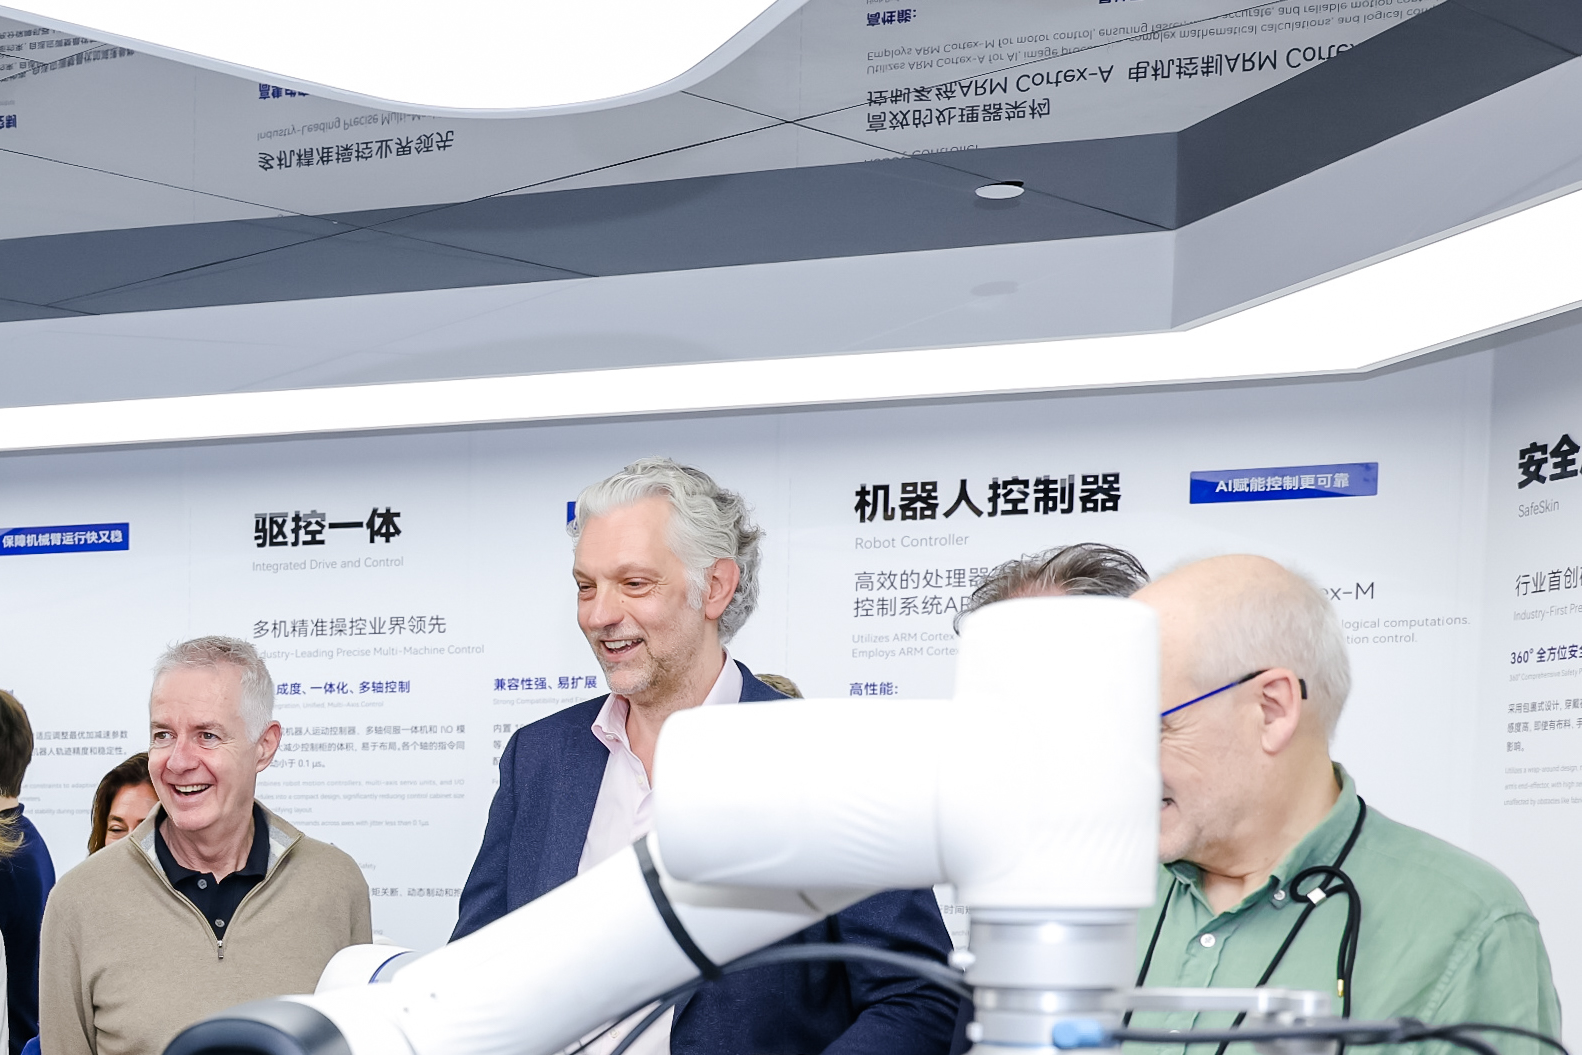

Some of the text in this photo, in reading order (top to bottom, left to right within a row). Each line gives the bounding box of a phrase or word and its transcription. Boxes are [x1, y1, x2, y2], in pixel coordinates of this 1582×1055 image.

[1517, 433, 1582, 490] 安全
[1215, 473, 1351, 495] AI赋能控制更可靠
[854, 472, 1122, 524] 机器人控制器
[1518, 499, 1560, 519] SafeSkin
[254, 507, 403, 548] 驱控一体
[2, 530, 123, 549] 保障机械臂运行快又稳
[854, 533, 970, 550] Robot Controller
[252, 556, 404, 574] Integrated Drive and Control
[854, 567, 990, 592] 高效的处理器
[1514, 565, 1582, 598] 行业首创
[853, 595, 970, 617] 控制系统AR
[253, 614, 447, 640] 多机精准操控业界领先
[1383, 616, 1471, 631] computations.
[851, 631, 955, 644] Utilizes ARM Cortex
[1346, 635, 1369, 645] tion
[259, 644, 485, 662] dustry-Leading Precise Multi-Machine Control
[851, 646, 959, 661] Employs ARM Cortex
[1536, 643, 1582, 664] 全方位安
[493, 676, 598, 692] 兼容性强、易扩展
[849, 682, 899, 697] 高性能:
